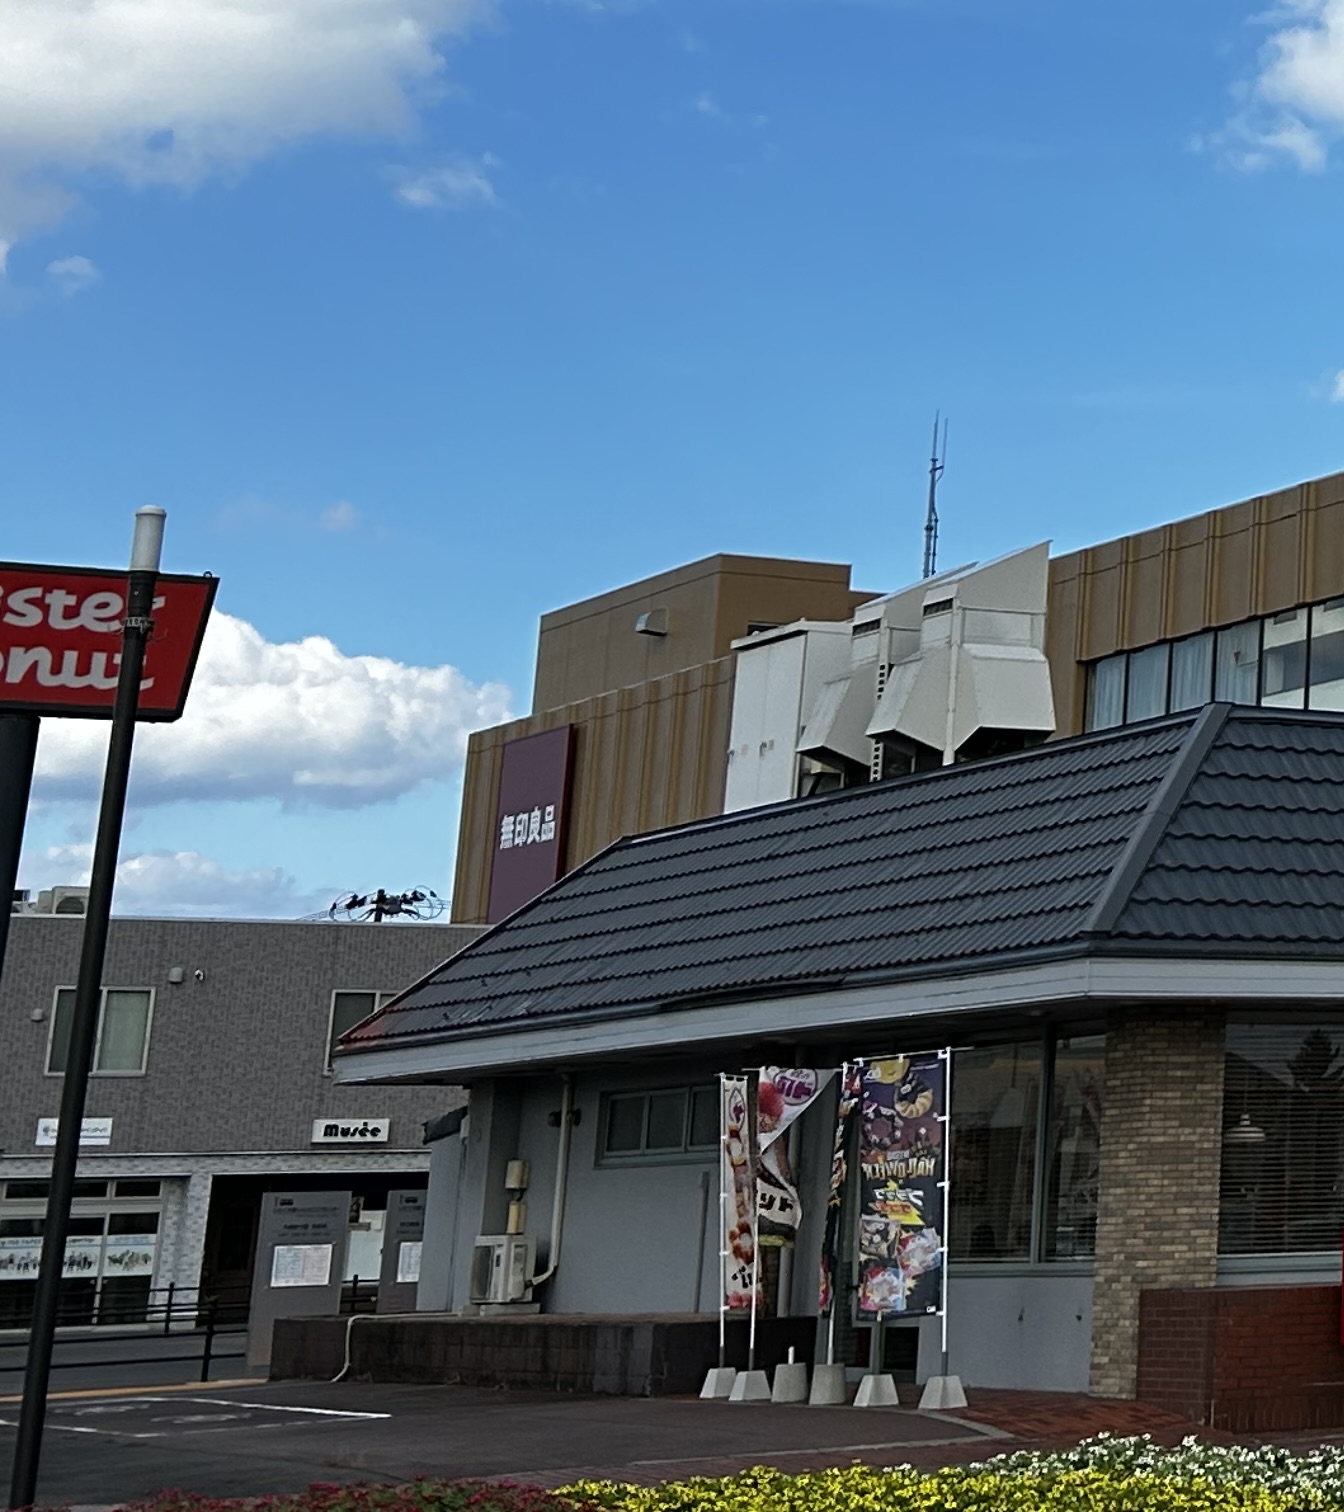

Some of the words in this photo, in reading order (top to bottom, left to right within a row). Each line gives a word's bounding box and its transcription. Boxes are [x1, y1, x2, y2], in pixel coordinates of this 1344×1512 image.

[0, 585, 167, 633] ste
[499, 804, 556, 850] 無印良品
